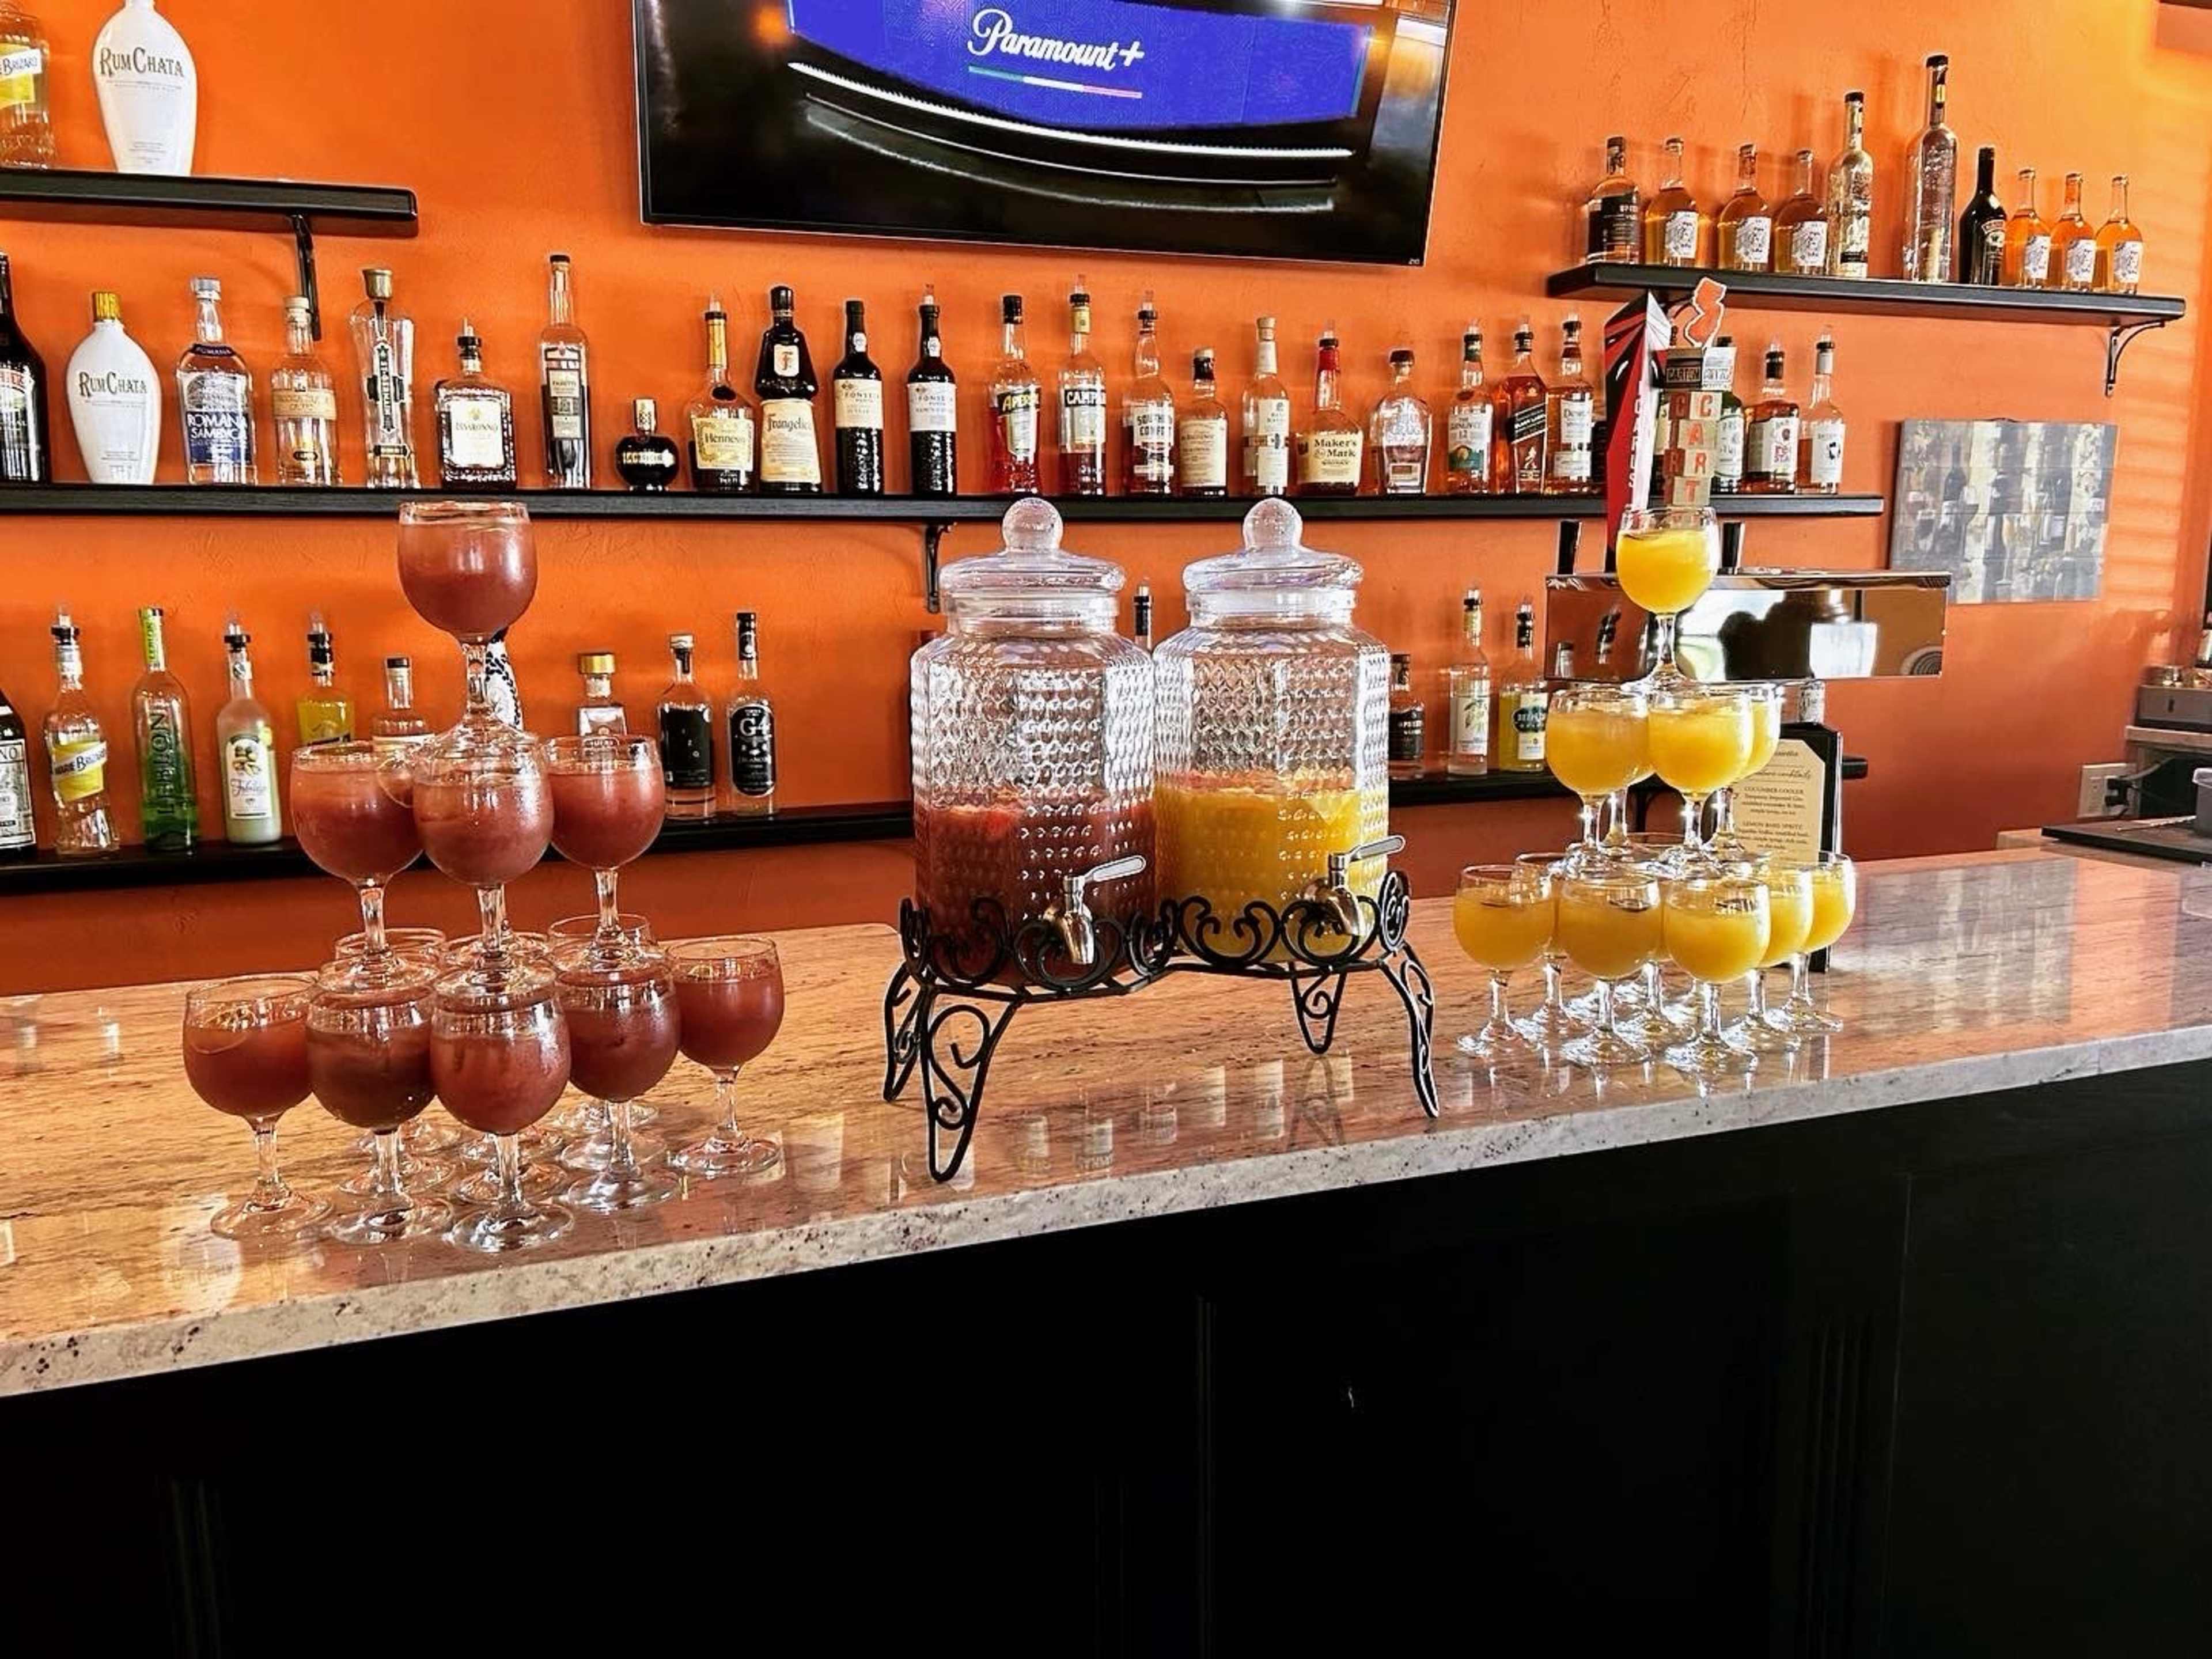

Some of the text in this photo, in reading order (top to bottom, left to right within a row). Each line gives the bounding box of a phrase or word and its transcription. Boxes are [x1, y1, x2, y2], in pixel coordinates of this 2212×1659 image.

[967, 8, 1145, 71] Paramount+
[187, 413, 247, 429] ROMANA
[1313, 438, 1357, 448] Maker's
[1327, 448, 1356, 458] Mark
[740, 718, 770, 736] G4
